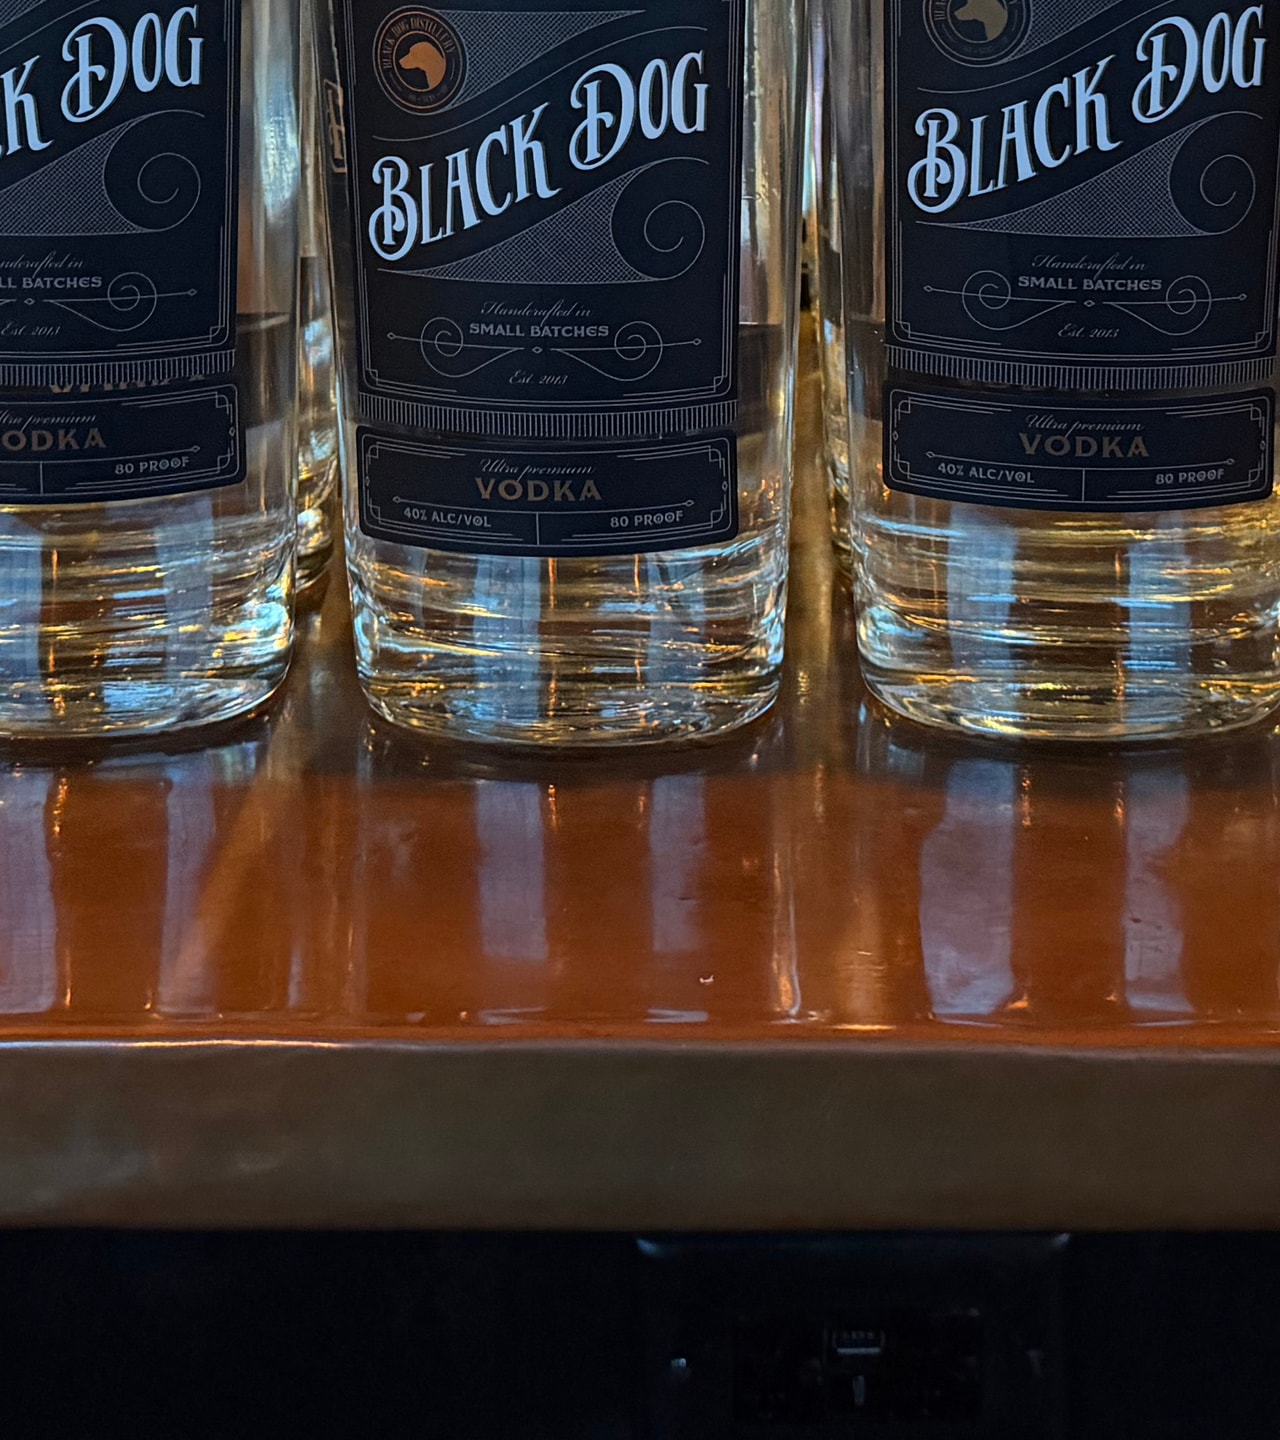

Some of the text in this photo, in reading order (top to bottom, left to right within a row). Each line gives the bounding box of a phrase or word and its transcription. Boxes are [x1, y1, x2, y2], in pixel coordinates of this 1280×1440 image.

[60, 4, 206, 124] DOG
[906, 4, 1267, 214] BLACK DOG
[368, 49, 710, 262] BLACK DOG
[22, 276, 104, 290] BATCHES
[1017, 274, 1163, 291] SMALL BATCHES
[469, 322, 610, 338] SMALL BATCHES
[1018, 431, 1150, 459] VODKA
[114, 457, 190, 475] 80 PROOF
[938, 461, 1035, 484] 40% ALC/VOL
[1155, 468, 1226, 486] 80 PROOF
[474, 476, 602, 502] VODKA
[403, 506, 492, 528] 40% ALC/VOL
[609, 510, 684, 528] 80 PROOF
